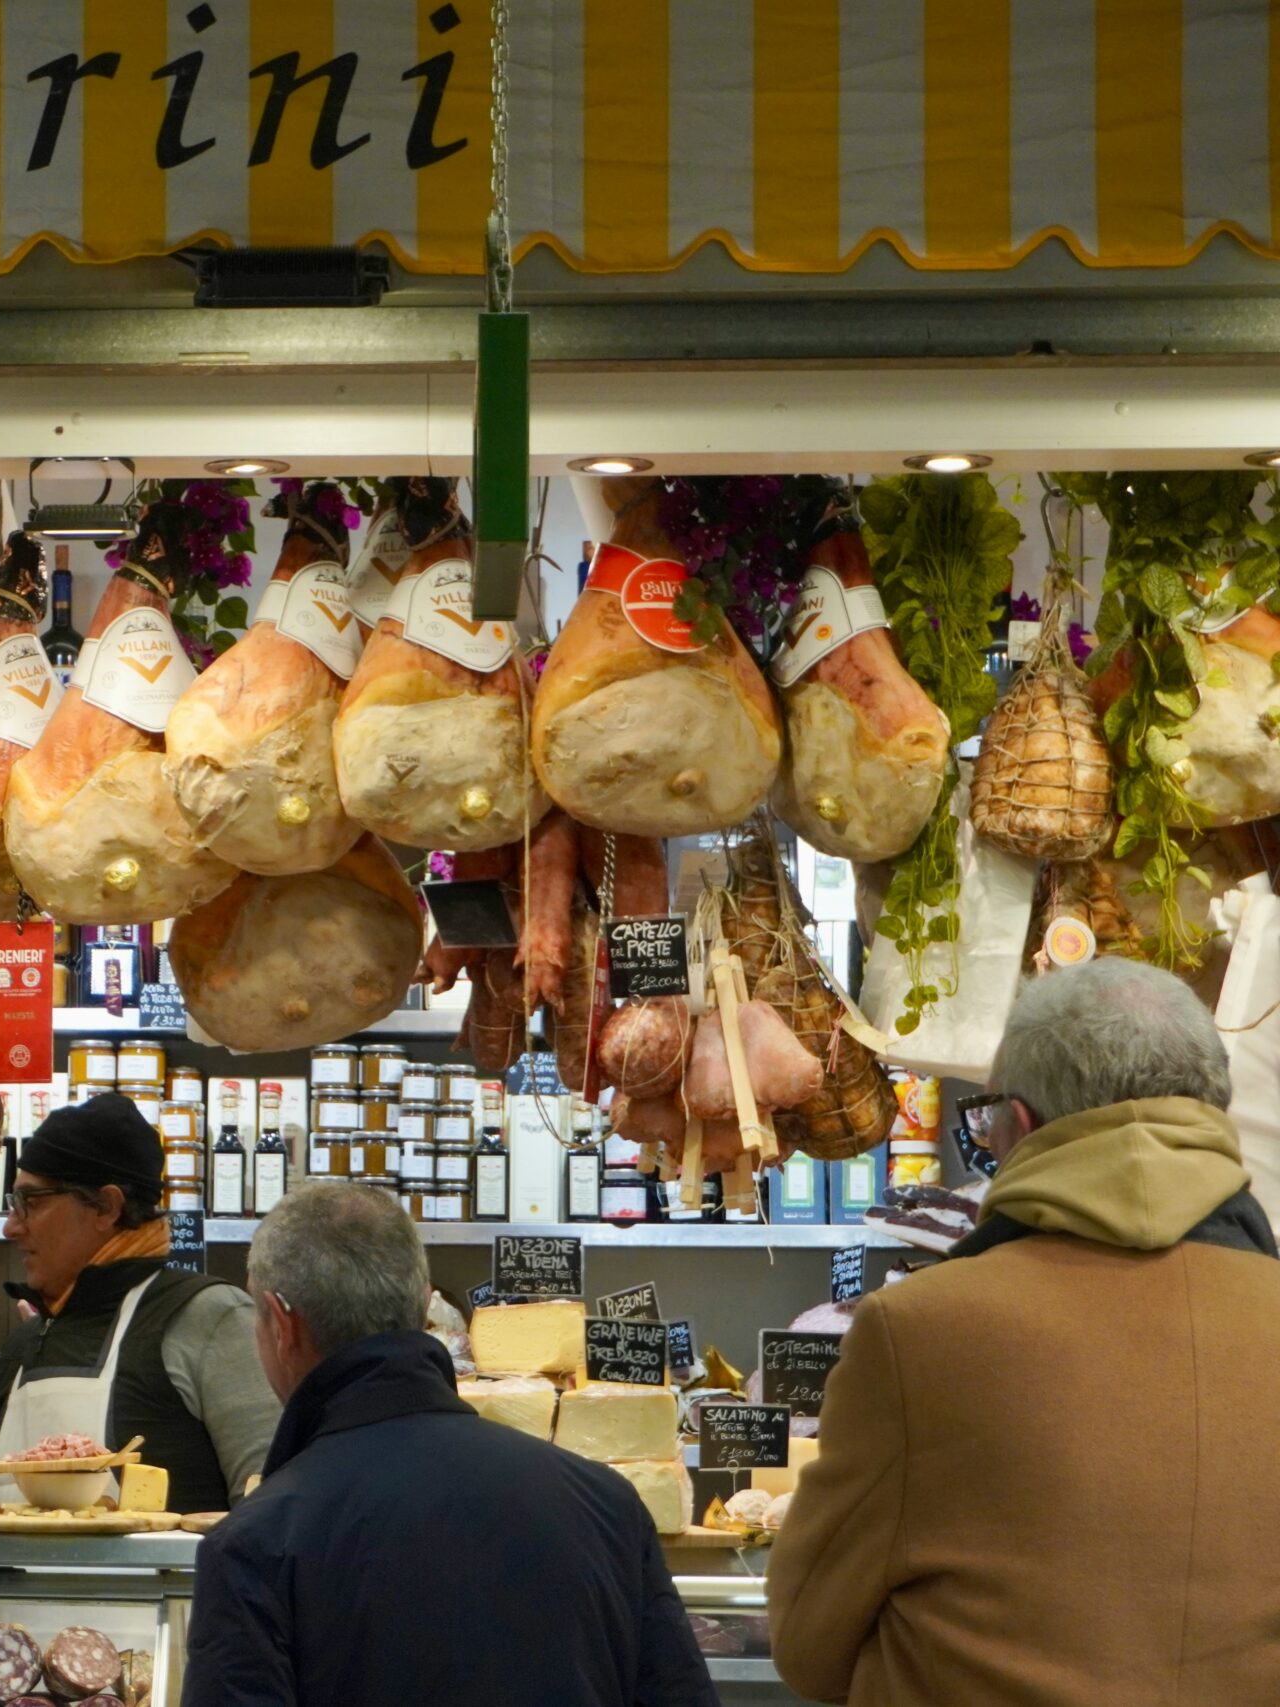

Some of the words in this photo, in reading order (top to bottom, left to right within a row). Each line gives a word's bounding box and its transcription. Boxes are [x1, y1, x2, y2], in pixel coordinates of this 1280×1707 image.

[117, 640, 172, 653] VILLANI
[611, 921, 682, 940] CAPPELLO
[627, 940, 672, 958] PRETE
[499, 1237, 577, 1258] PUZZONE
[587, 1322, 665, 1346] GRADEVOLE
[587, 1344, 659, 1365] PREDAZZO
